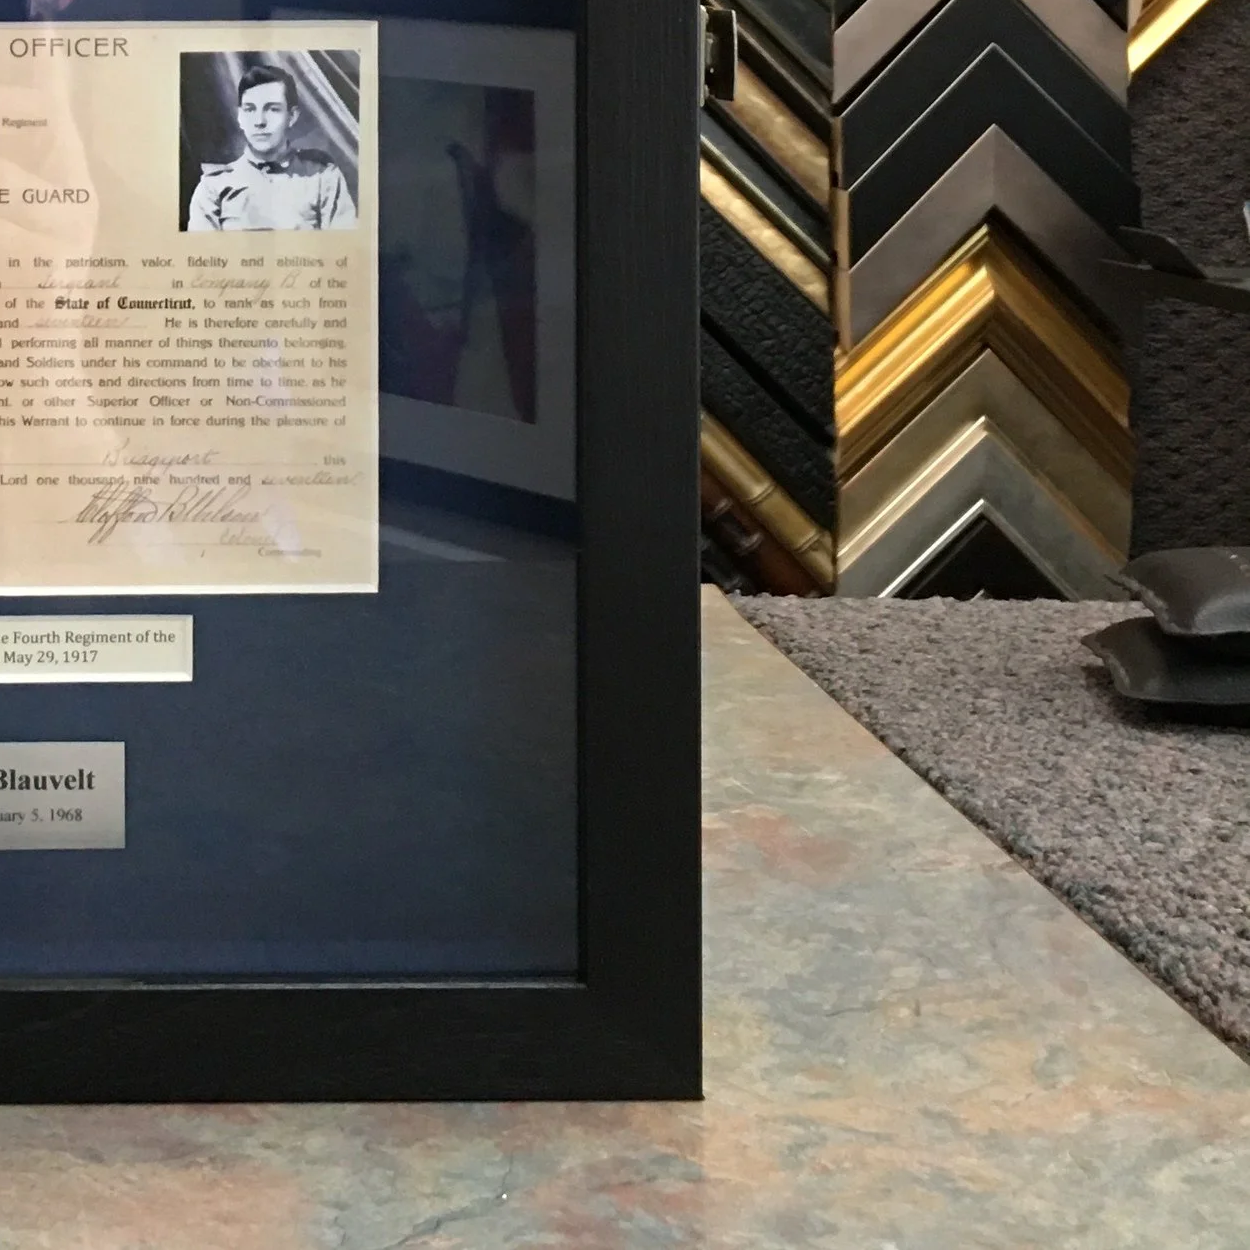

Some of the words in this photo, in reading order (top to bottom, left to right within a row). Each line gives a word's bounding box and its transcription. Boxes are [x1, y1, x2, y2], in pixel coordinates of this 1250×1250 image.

[10, 38, 128, 58] OFFICER
[22, 189, 89, 204] GUARD
[9, 258, 20, 267] in
[34, 257, 53, 267] the
[188, 256, 228, 268] fidelity
[241, 257, 264, 267] and
[336, 256, 347, 267] of
[13, 632, 60, 645] Fourth
[65, 631, 132, 647] Regiment
[136, 630, 151, 643] of
[154, 630, 175, 643] the
[4, 650, 33, 666] May
[37, 651, 58, 665] 29,
[63, 650, 98, 663] 1917
[51, 808, 82, 822] 1968
